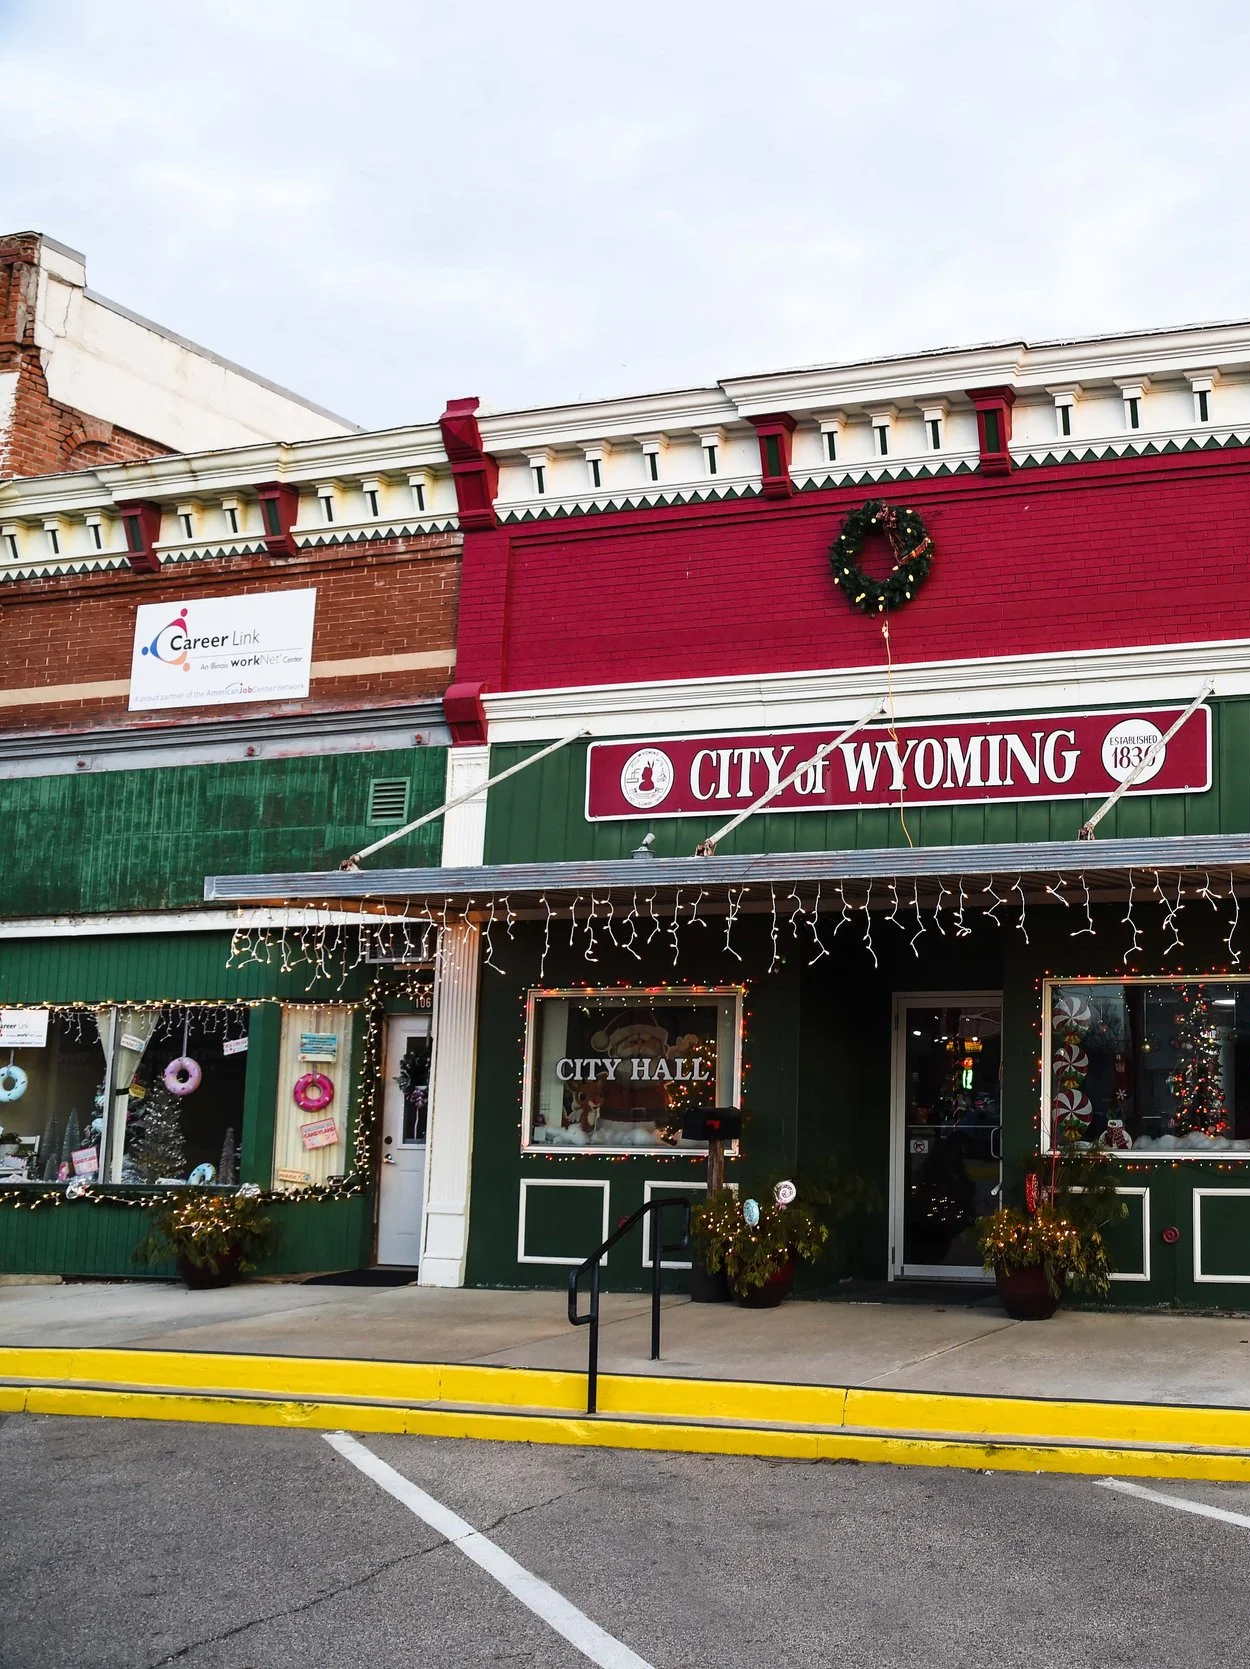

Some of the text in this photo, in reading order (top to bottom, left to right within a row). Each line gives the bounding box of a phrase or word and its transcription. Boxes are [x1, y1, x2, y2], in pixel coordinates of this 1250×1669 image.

[170, 629, 260, 651] Career Link
[283, 656, 303, 664] Center
[140, 693, 159, 703] proud
[160, 692, 185, 702] partner
[186, 690, 193, 698] of
[277, 683, 304, 691] network
[1110, 735, 1158, 745] ESTABLISHED
[690, 729, 1081, 801] CITY of WYOMING
[415, 997, 432, 1008] 106
[556, 1057, 710, 1081] CITY HALL
[304, 1126, 335, 1138] CANDYLAND
